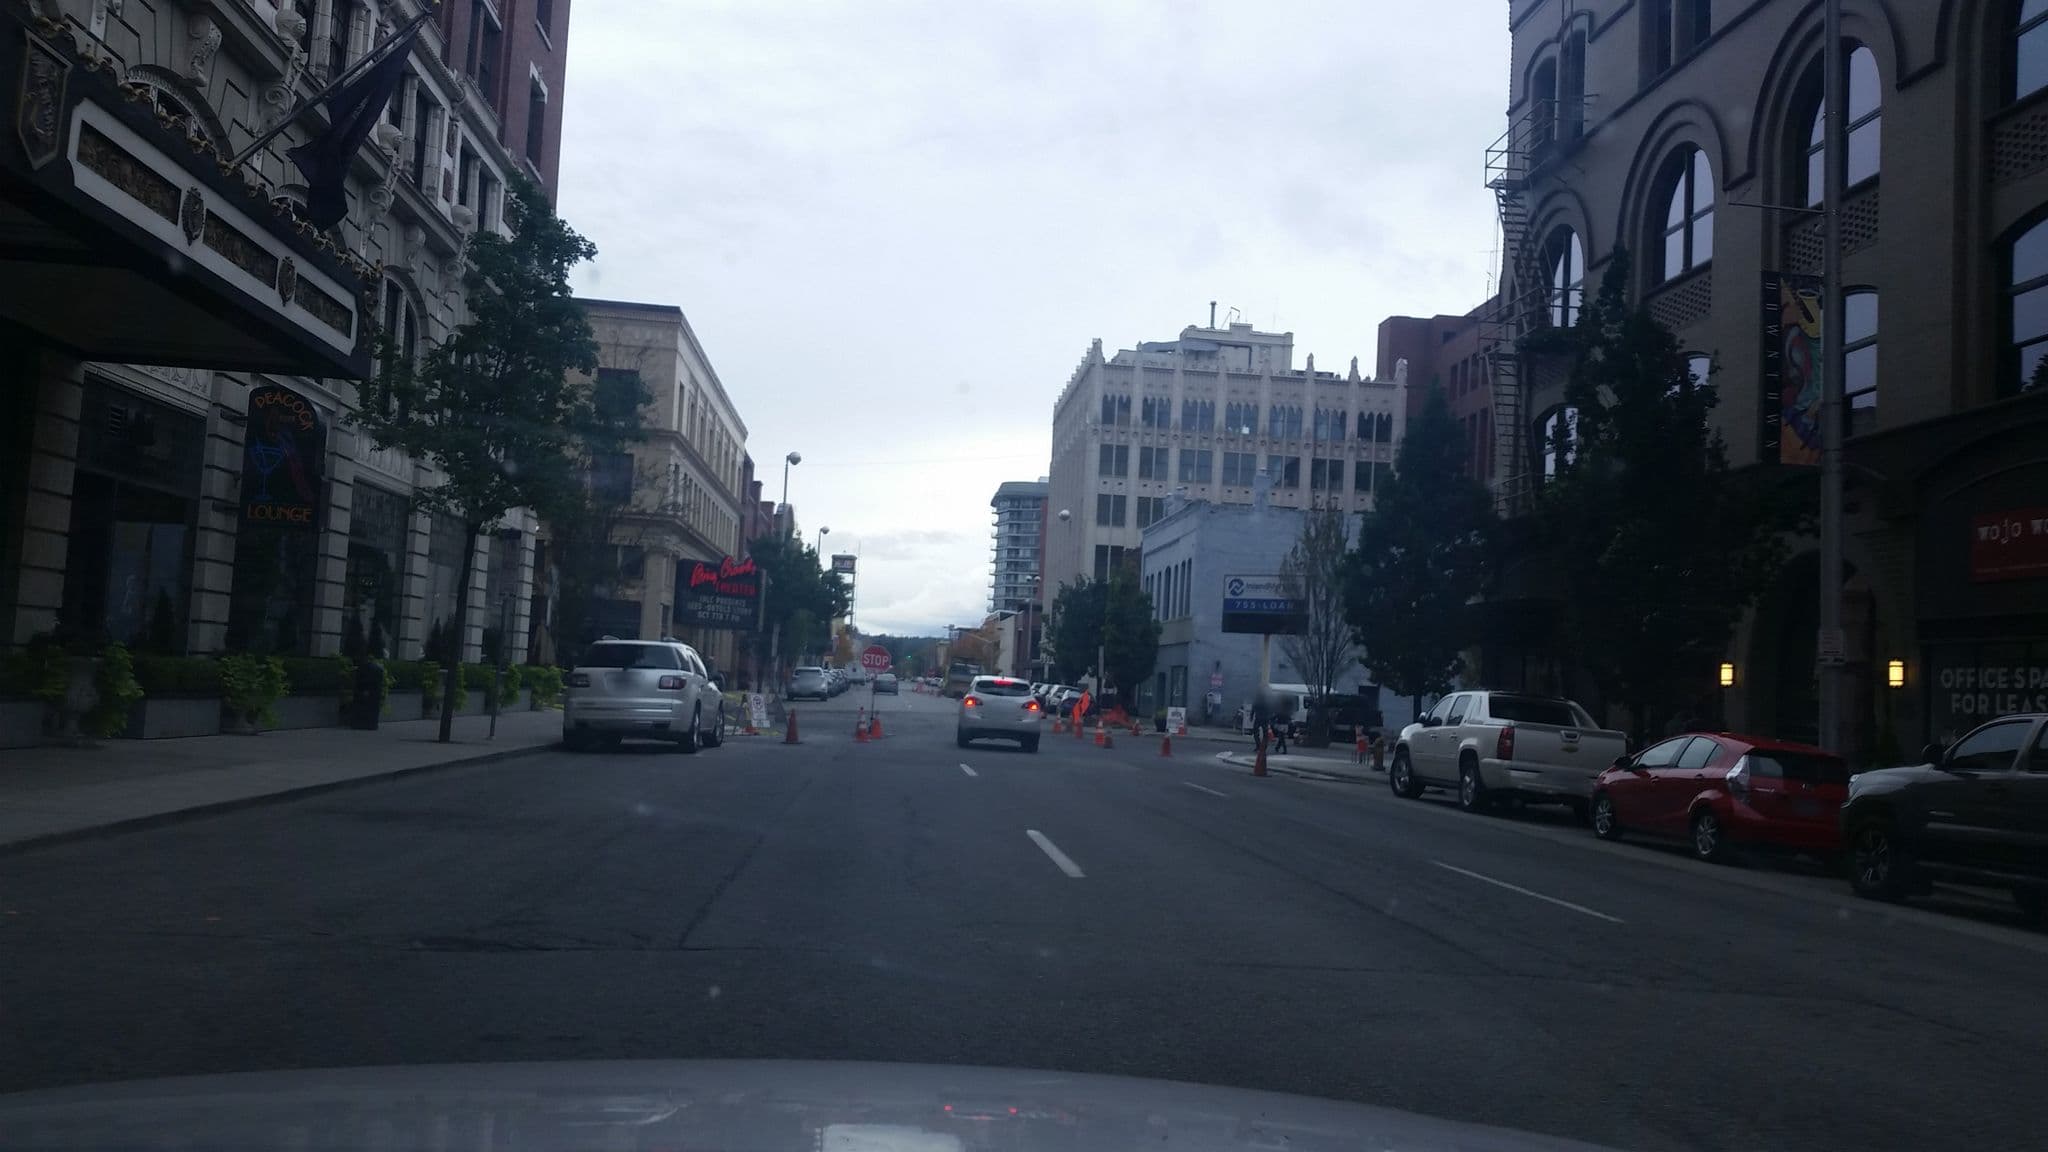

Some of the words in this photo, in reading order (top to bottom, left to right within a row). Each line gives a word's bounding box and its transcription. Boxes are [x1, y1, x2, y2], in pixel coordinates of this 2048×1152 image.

[255, 392, 314, 431] PEACOCK
[247, 503, 312, 521] LOUNGE
[1977, 518, 2022, 544] wojo
[863, 653, 889, 666] STOP
[1941, 667, 2008, 688] OFFICE
[1952, 693, 1989, 714] FOR
